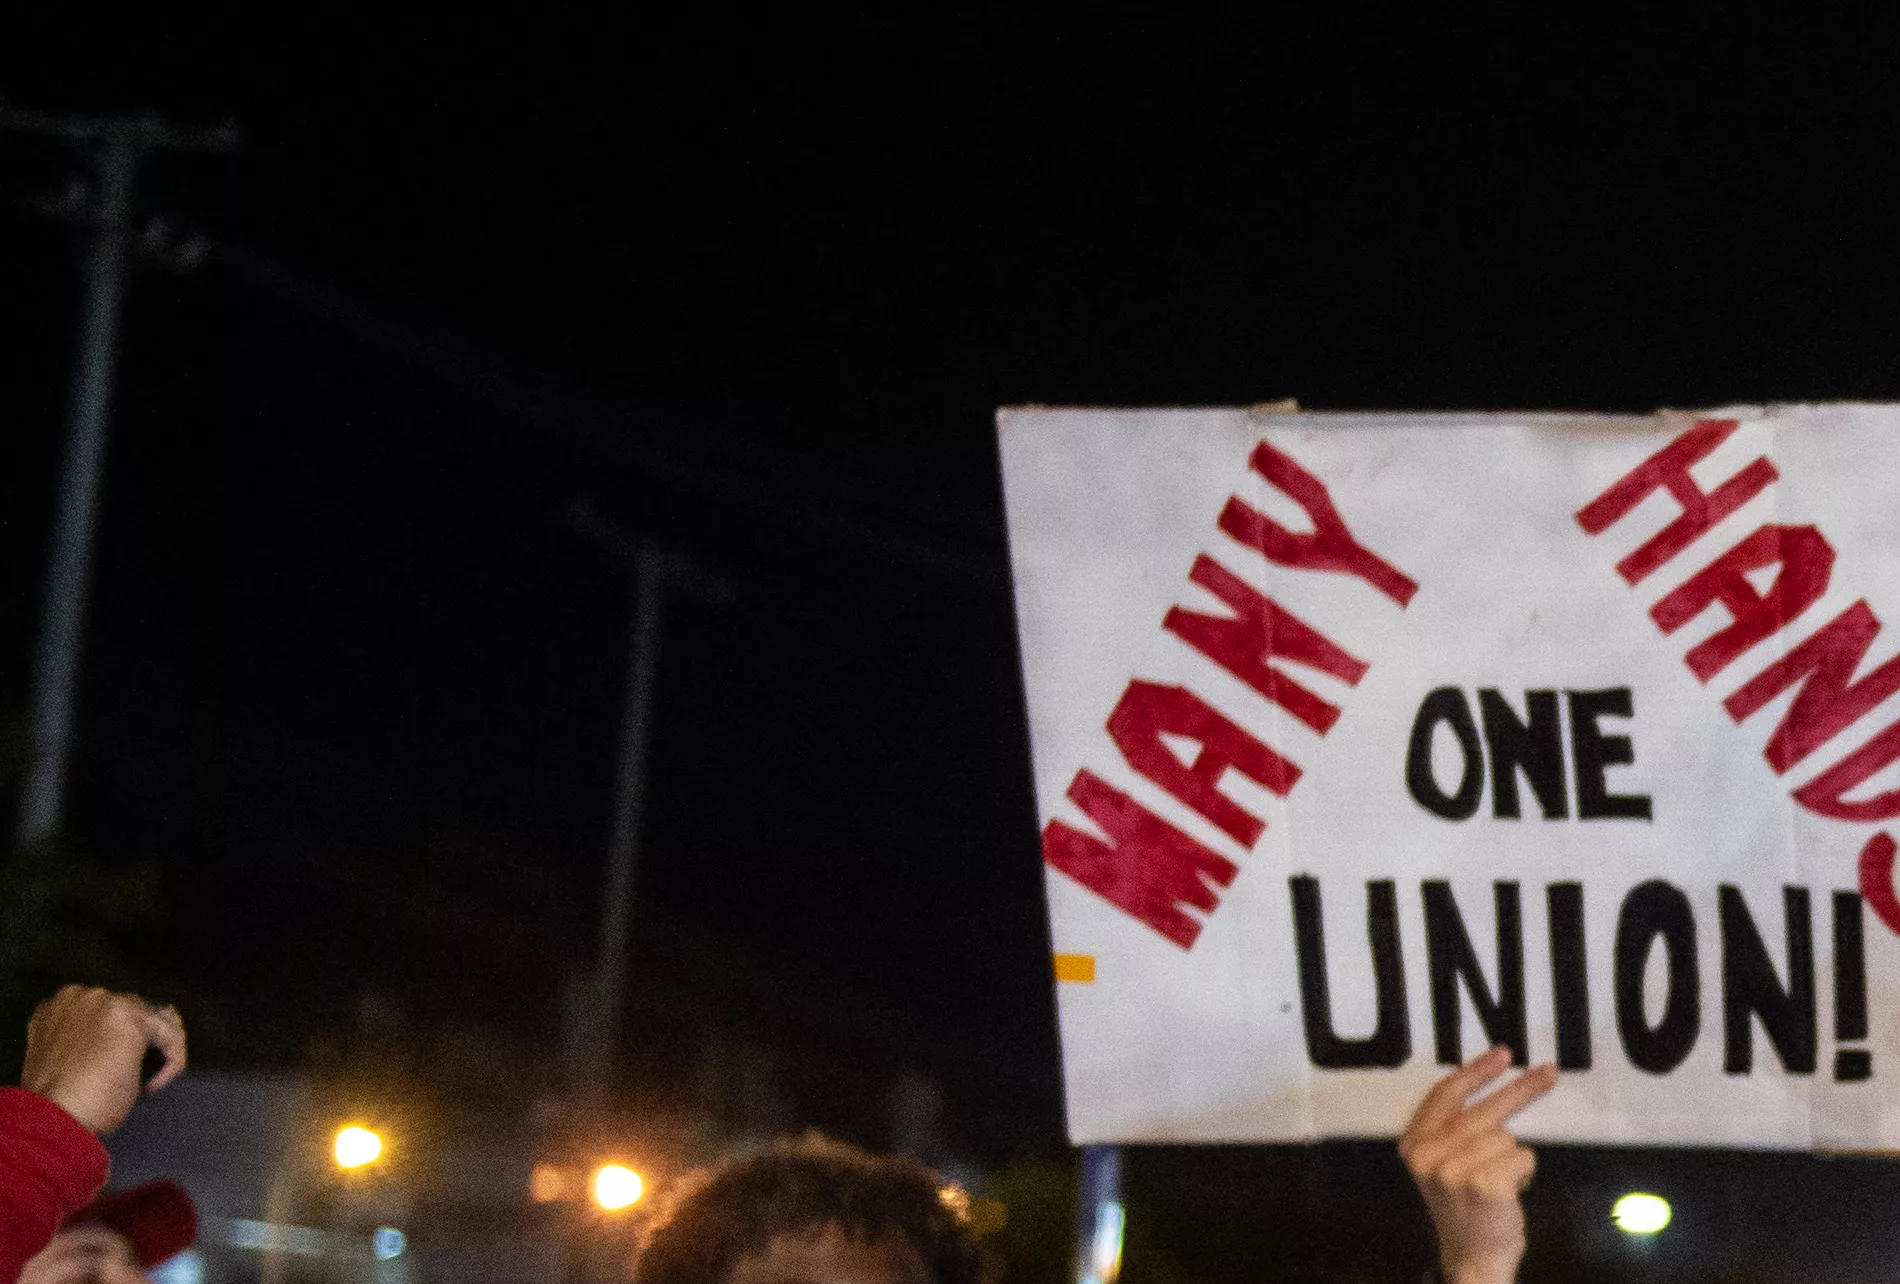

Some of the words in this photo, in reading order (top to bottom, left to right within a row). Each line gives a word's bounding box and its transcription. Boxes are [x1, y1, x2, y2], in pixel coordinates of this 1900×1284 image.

[1041, 439, 1420, 952] MANY
[1405, 685, 1653, 823] ONE
[1287, 873, 1873, 1083] UNION!
